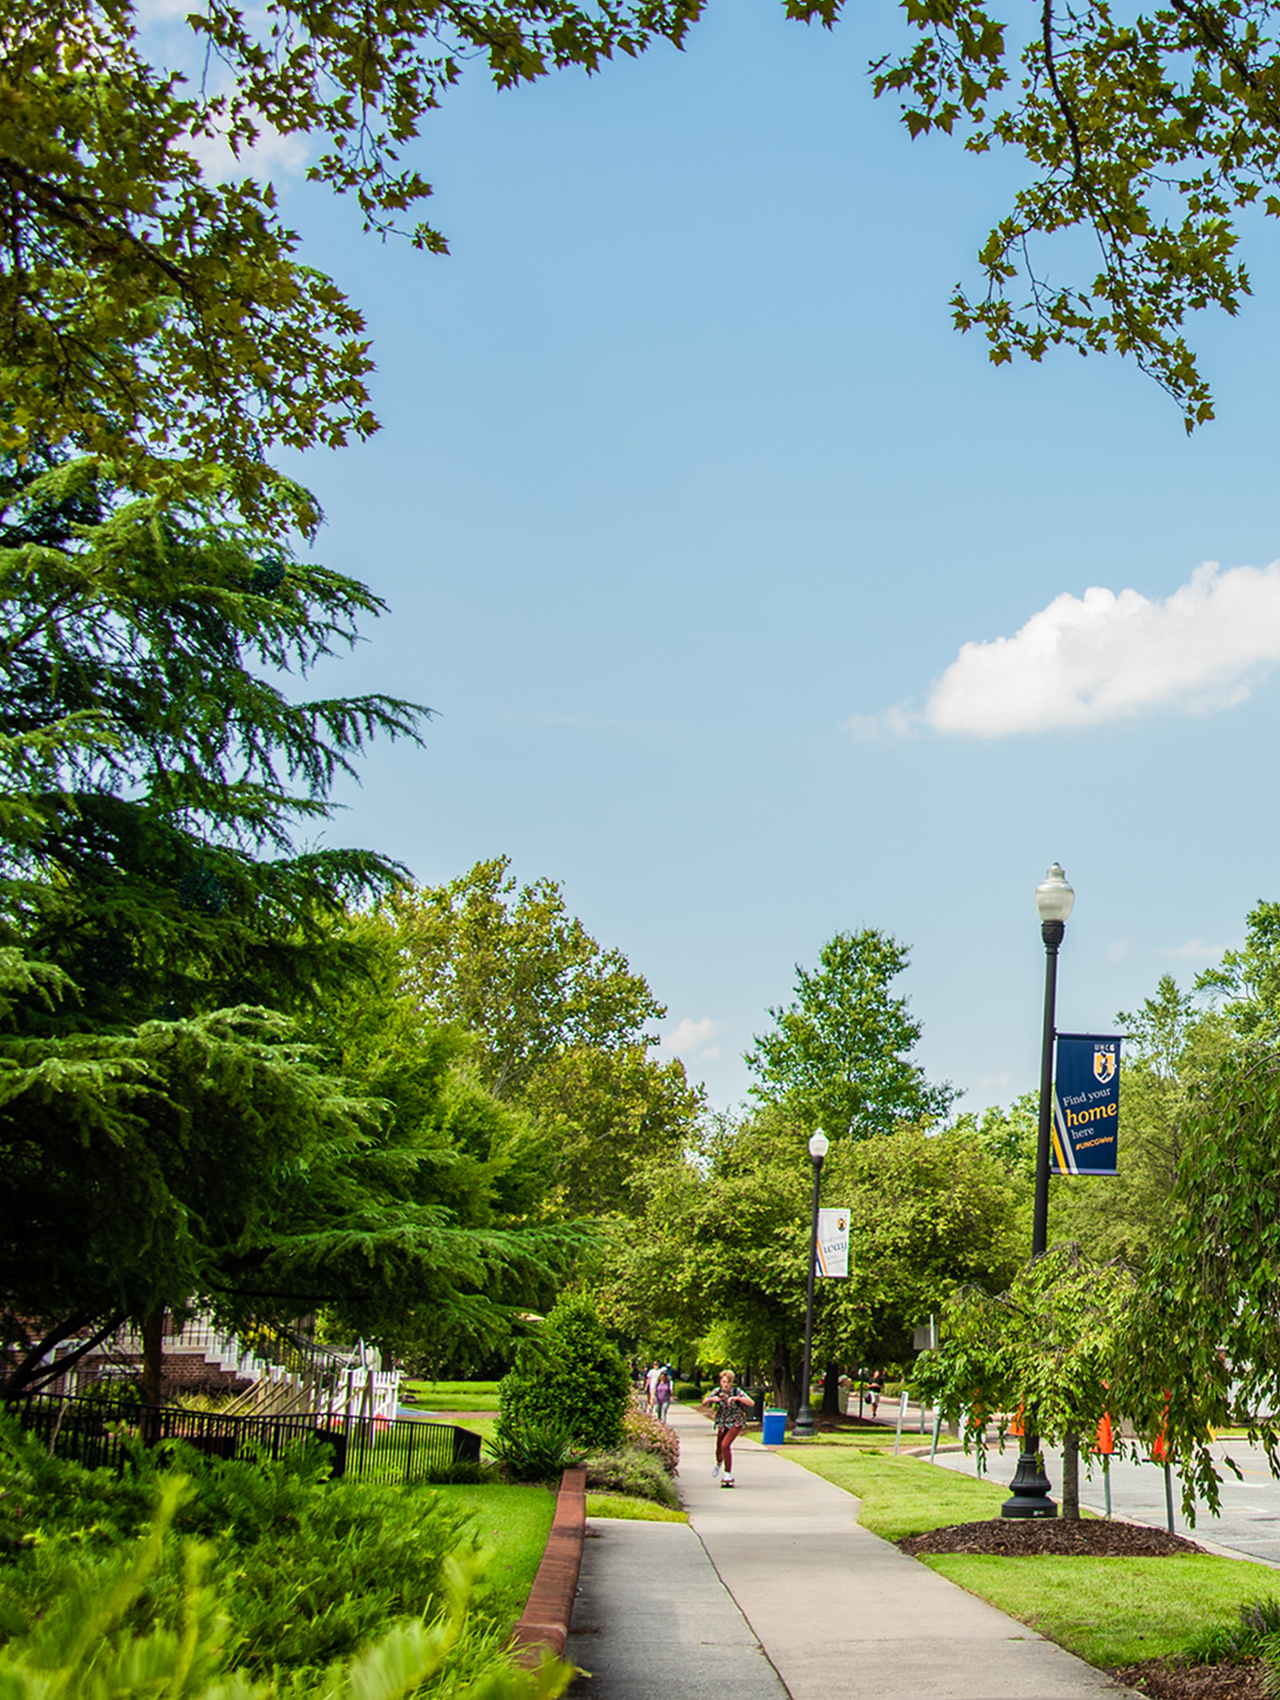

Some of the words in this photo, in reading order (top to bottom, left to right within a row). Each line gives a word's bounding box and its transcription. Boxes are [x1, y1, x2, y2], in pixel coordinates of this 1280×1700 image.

[1062, 1091, 1087, 1107] Find
[1088, 1087, 1111, 1103] your
[1065, 1102, 1118, 1128] home
[1070, 1127, 1095, 1140] here
[823, 1241, 847, 1254] way
